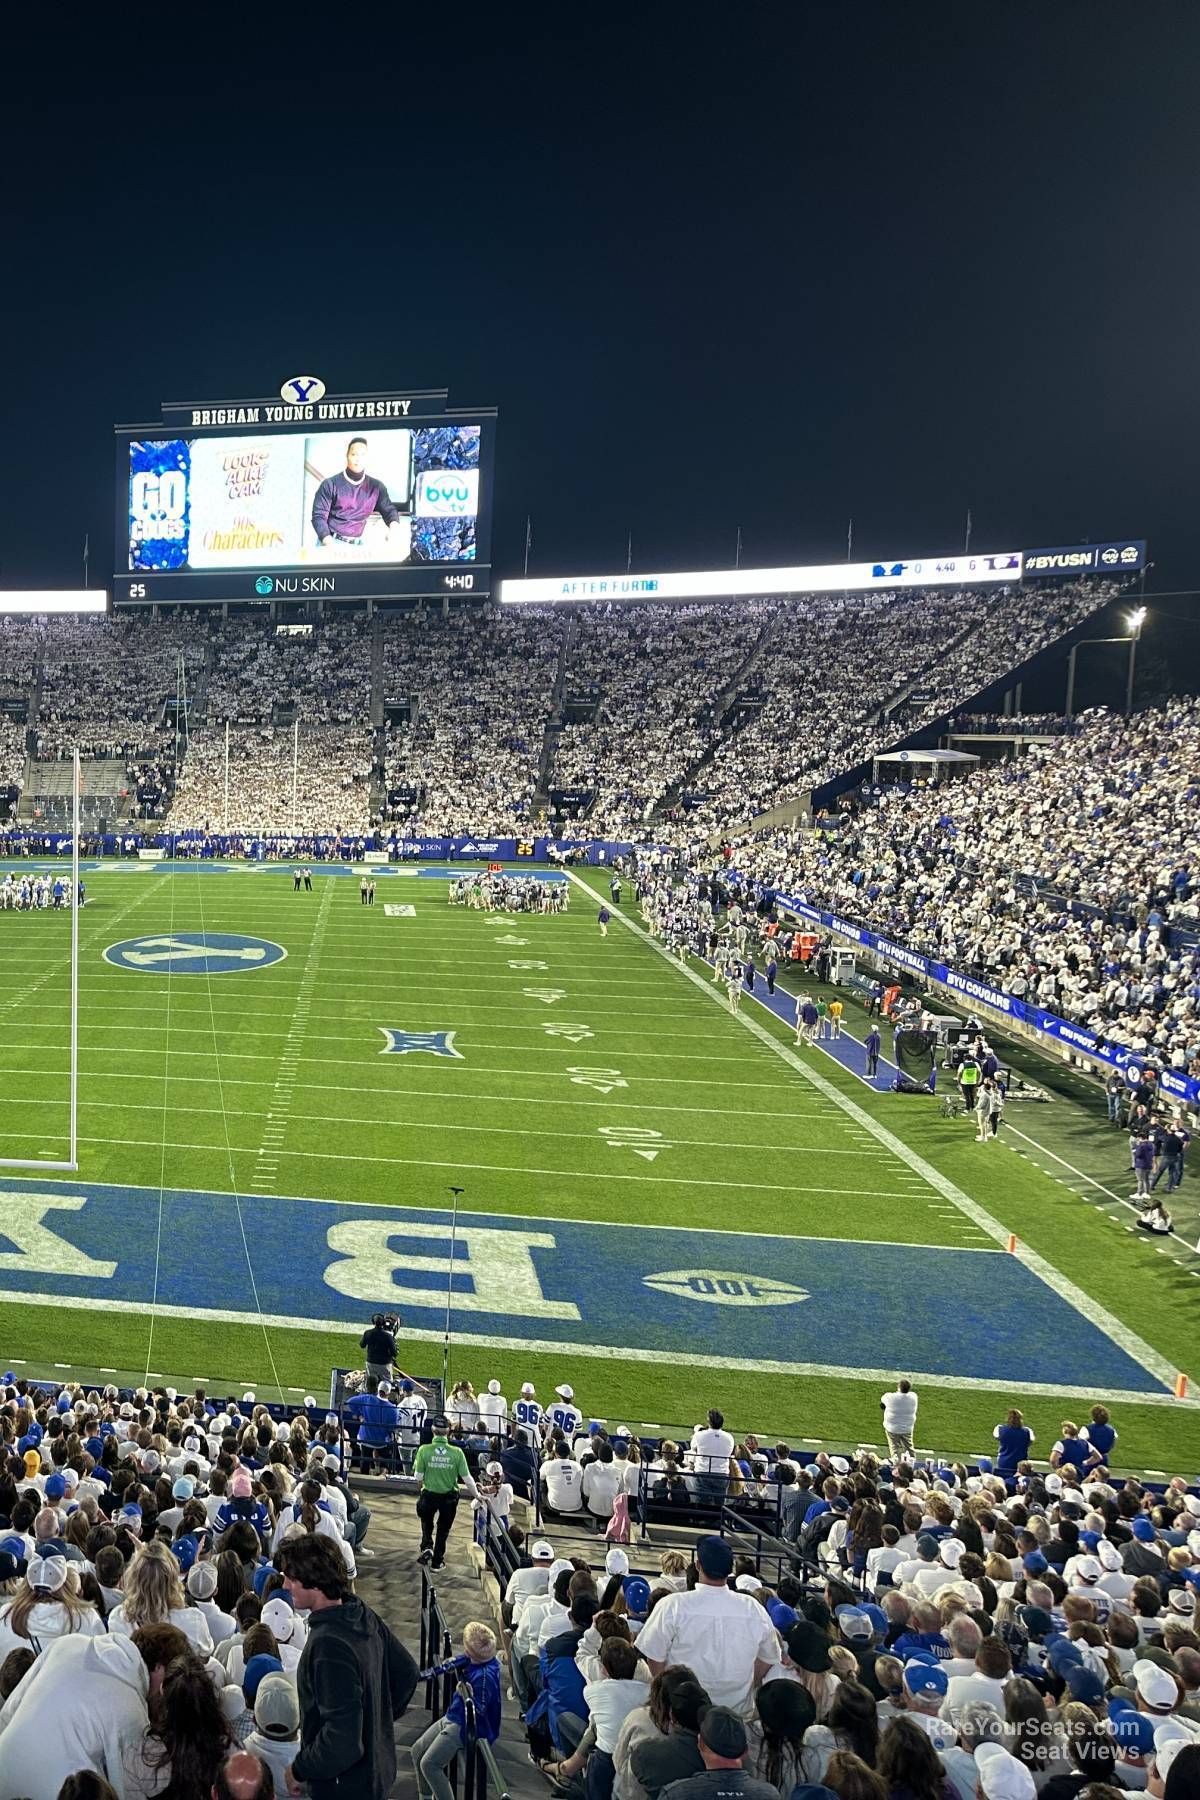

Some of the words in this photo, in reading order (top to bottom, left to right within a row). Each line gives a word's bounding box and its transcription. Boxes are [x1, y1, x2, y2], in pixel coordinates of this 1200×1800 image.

[287, 379, 318, 402] Y
[192, 408, 259, 426] BRIGHAM
[266, 404, 314, 422] YOUNG
[318, 400, 411, 420] UNIVERSITY
[132, 470, 186, 521] GO
[203, 529, 284, 551] Characters
[1025, 552, 1092, 569] #BYUSN
[130, 583, 145, 597] 25
[275, 578, 298, 592] NU
[301, 577, 335, 592] SKIN
[445, 574, 474, 590] 4:40
[517, 844, 533, 855] 25
[877, 940, 892, 954] BYU
[891, 946, 926, 971] FOOTBALL
[947, 973, 967, 990] BYU
[966, 981, 1010, 1011] COUGARS
[598, 1125, 673, 1149] 10
[516, 1402, 540, 1425] 96
[552, 1409, 577, 1434] 96
